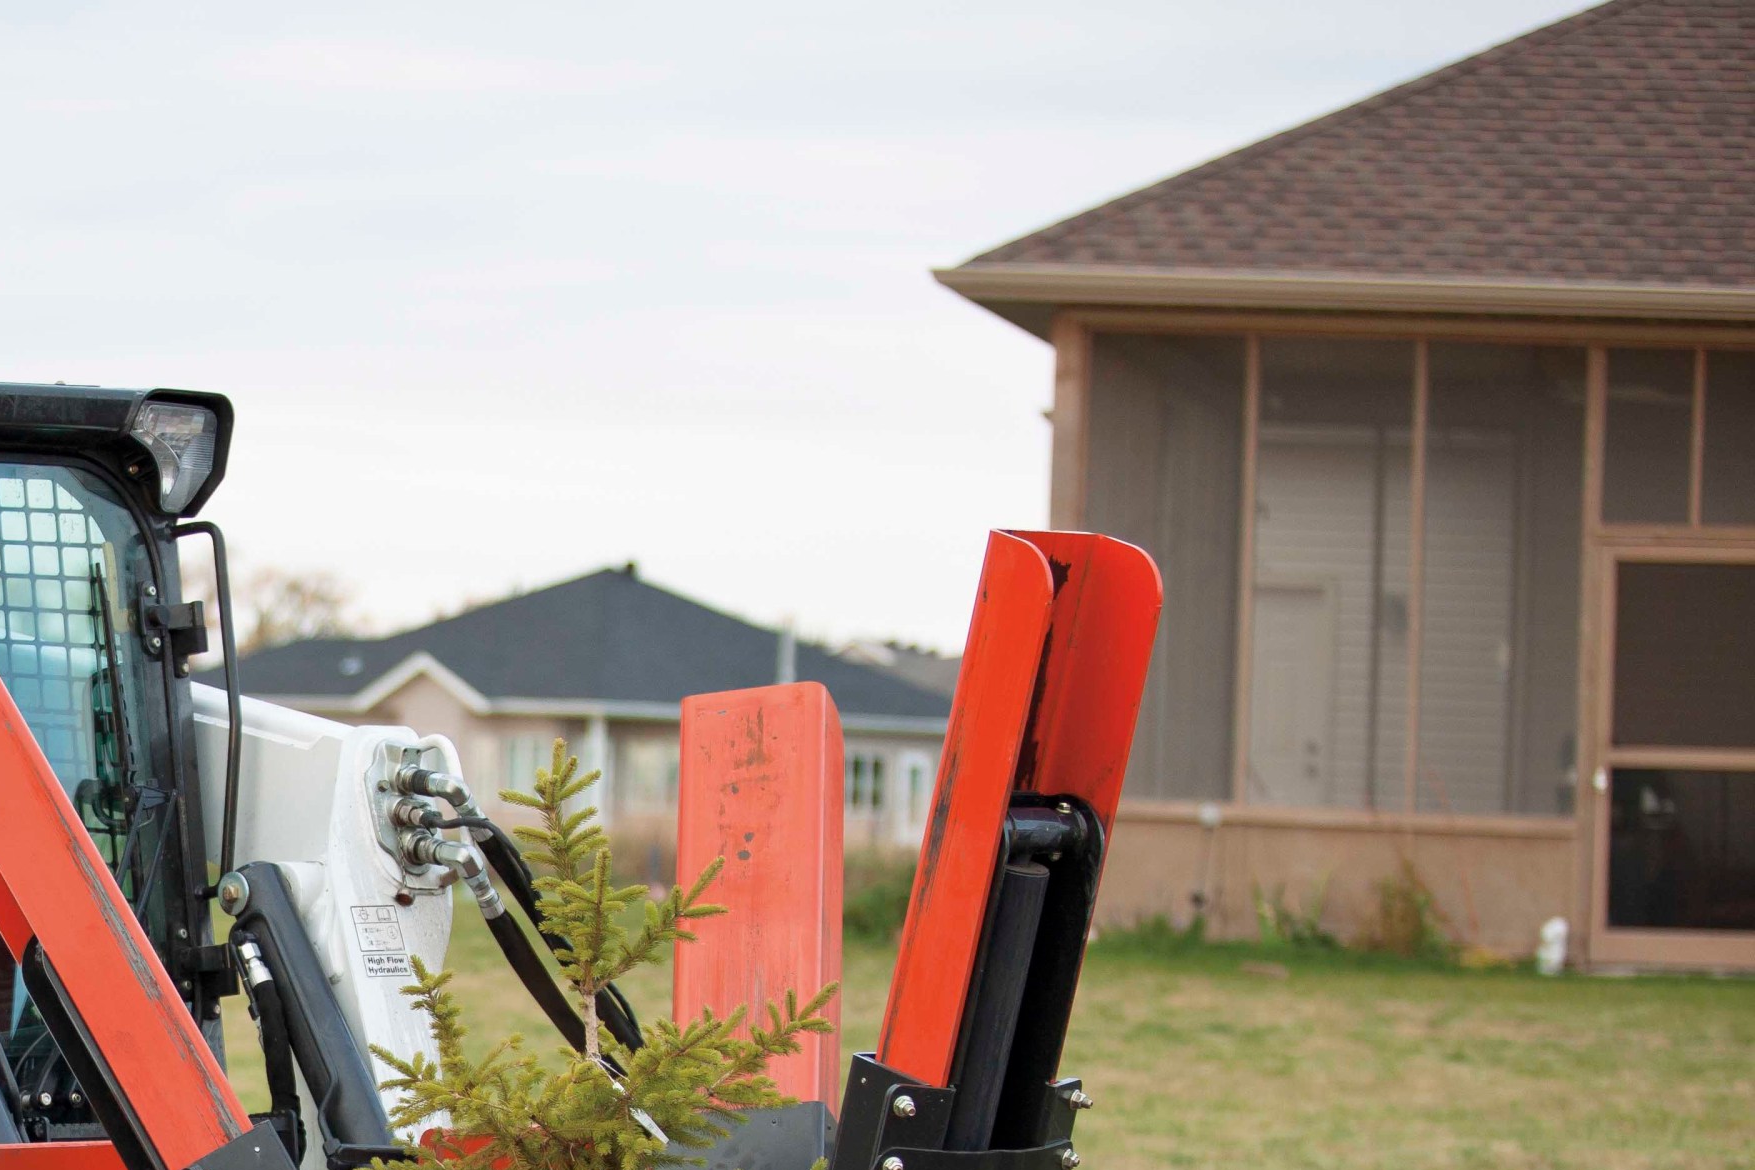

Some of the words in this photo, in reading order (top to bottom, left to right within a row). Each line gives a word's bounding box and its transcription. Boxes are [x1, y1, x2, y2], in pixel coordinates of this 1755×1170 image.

[367, 956, 385, 965] High
[386, 956, 405, 964] Flow
[368, 966, 408, 975] Hydraulics
